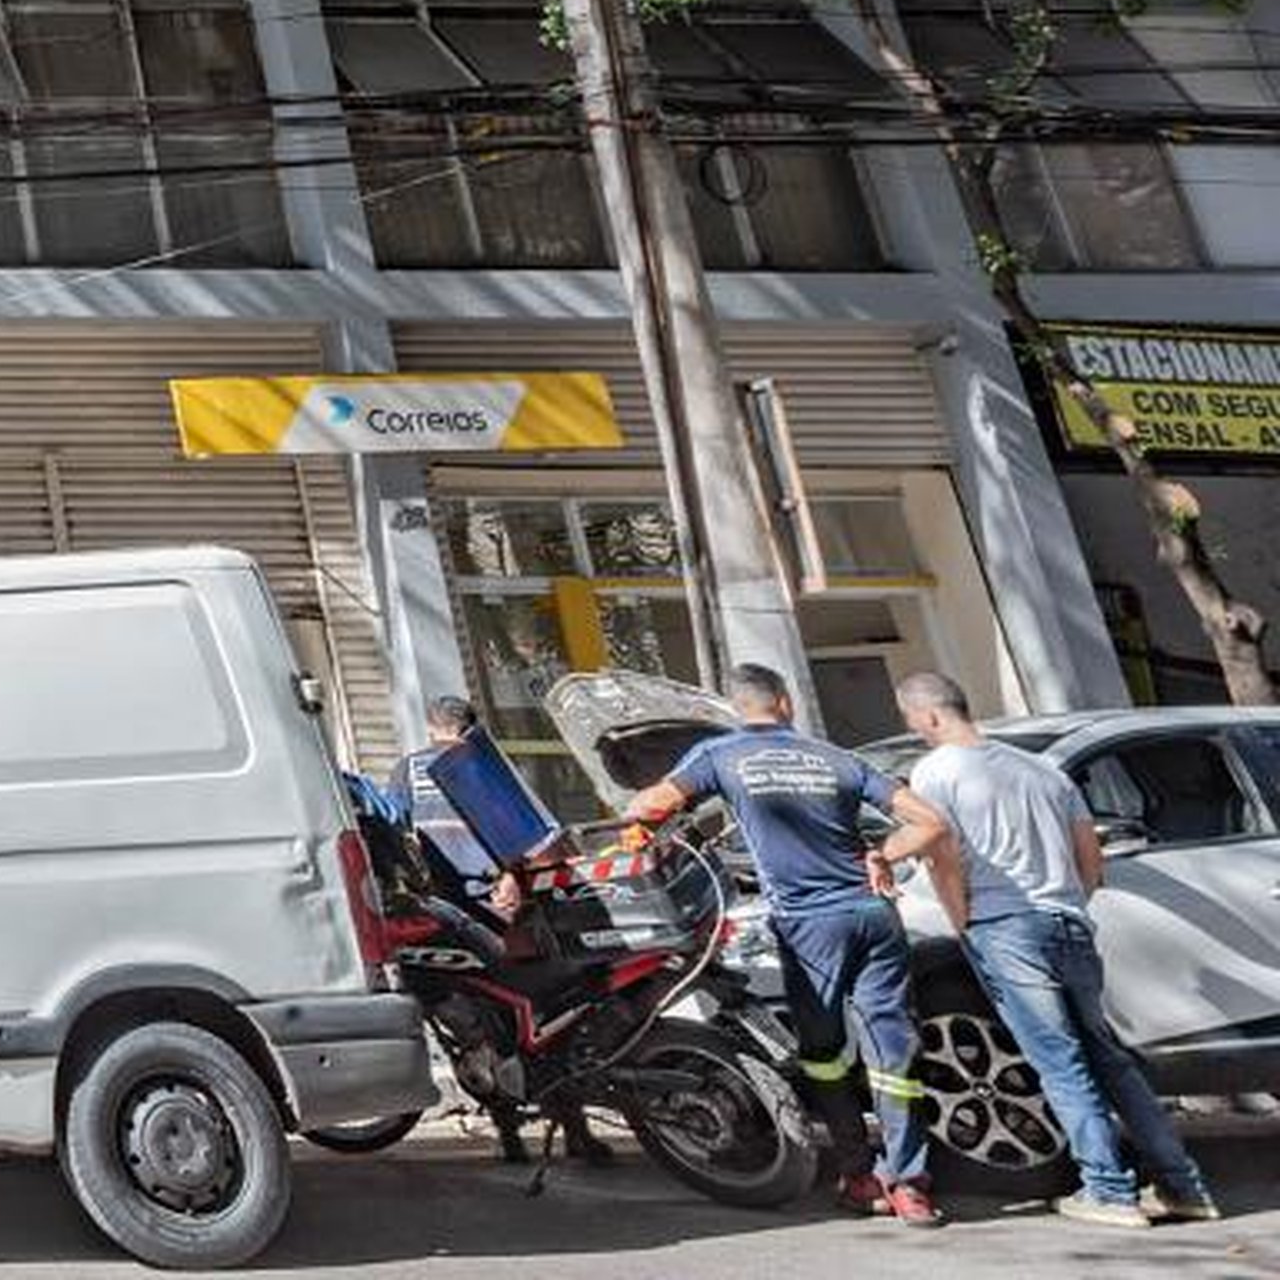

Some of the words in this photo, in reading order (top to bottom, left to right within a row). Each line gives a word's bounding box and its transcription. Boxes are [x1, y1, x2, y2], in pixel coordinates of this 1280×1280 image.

[1131, 390, 1201, 417] COM
[366, 409, 488, 434] Correios
[1134, 421, 1235, 447] ENSAL
